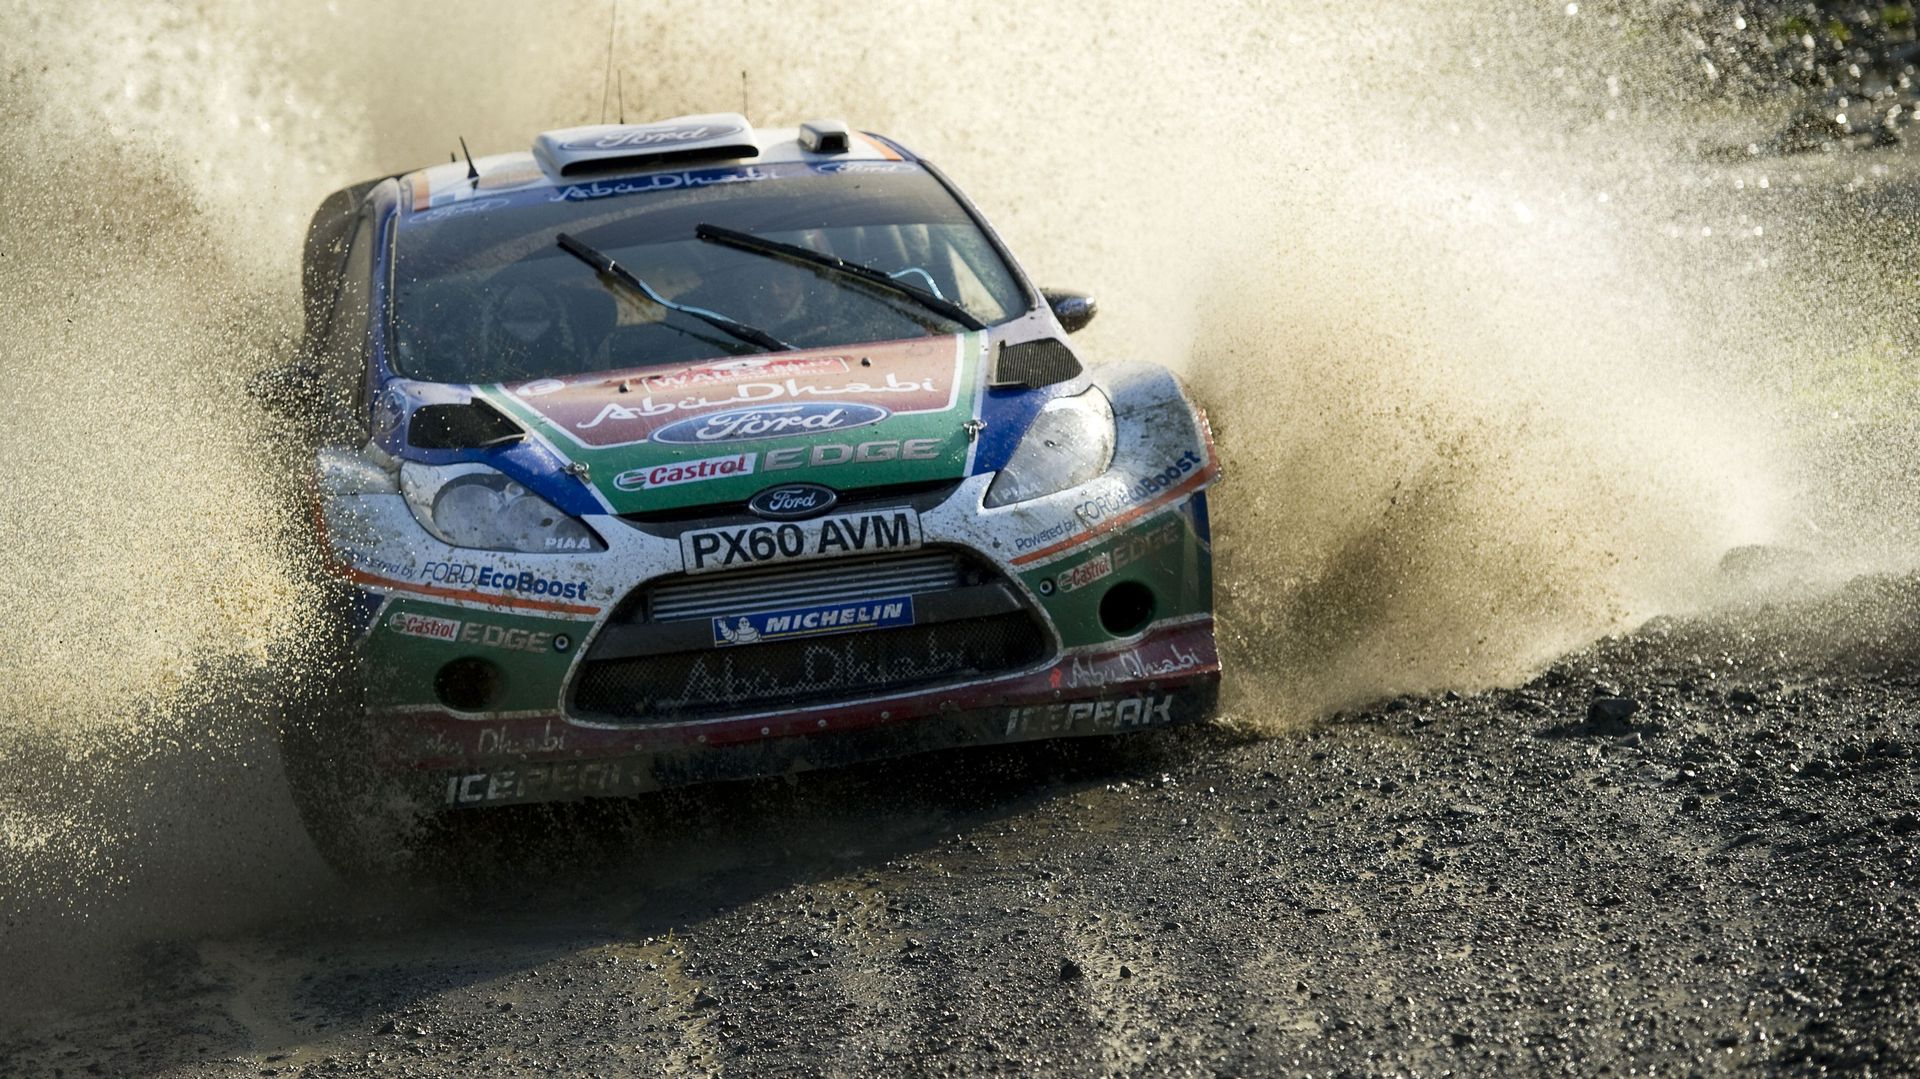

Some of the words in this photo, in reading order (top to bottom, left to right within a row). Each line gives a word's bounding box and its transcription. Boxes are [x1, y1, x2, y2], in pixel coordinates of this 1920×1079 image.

[596, 127, 708, 148] Ford
[577, 396, 732, 429] Abu
[735, 374, 938, 403] Dhabi
[695, 404, 846, 441] Ford
[649, 454, 747, 485] Castrol
[762, 438, 944, 473] EDGE
[768, 488, 817, 512] Ford
[544, 536, 592, 551] PIAA
[691, 523, 804, 569] PX60
[817, 512, 912, 554] AVM
[1015, 523, 1063, 551] Powered
[401, 564, 417, 580] by
[1072, 558, 1111, 587] Castrol
[765, 602, 904, 634] MICHELIN
[405, 616, 456, 639] Castrol
[459, 622, 552, 654] EDGE
